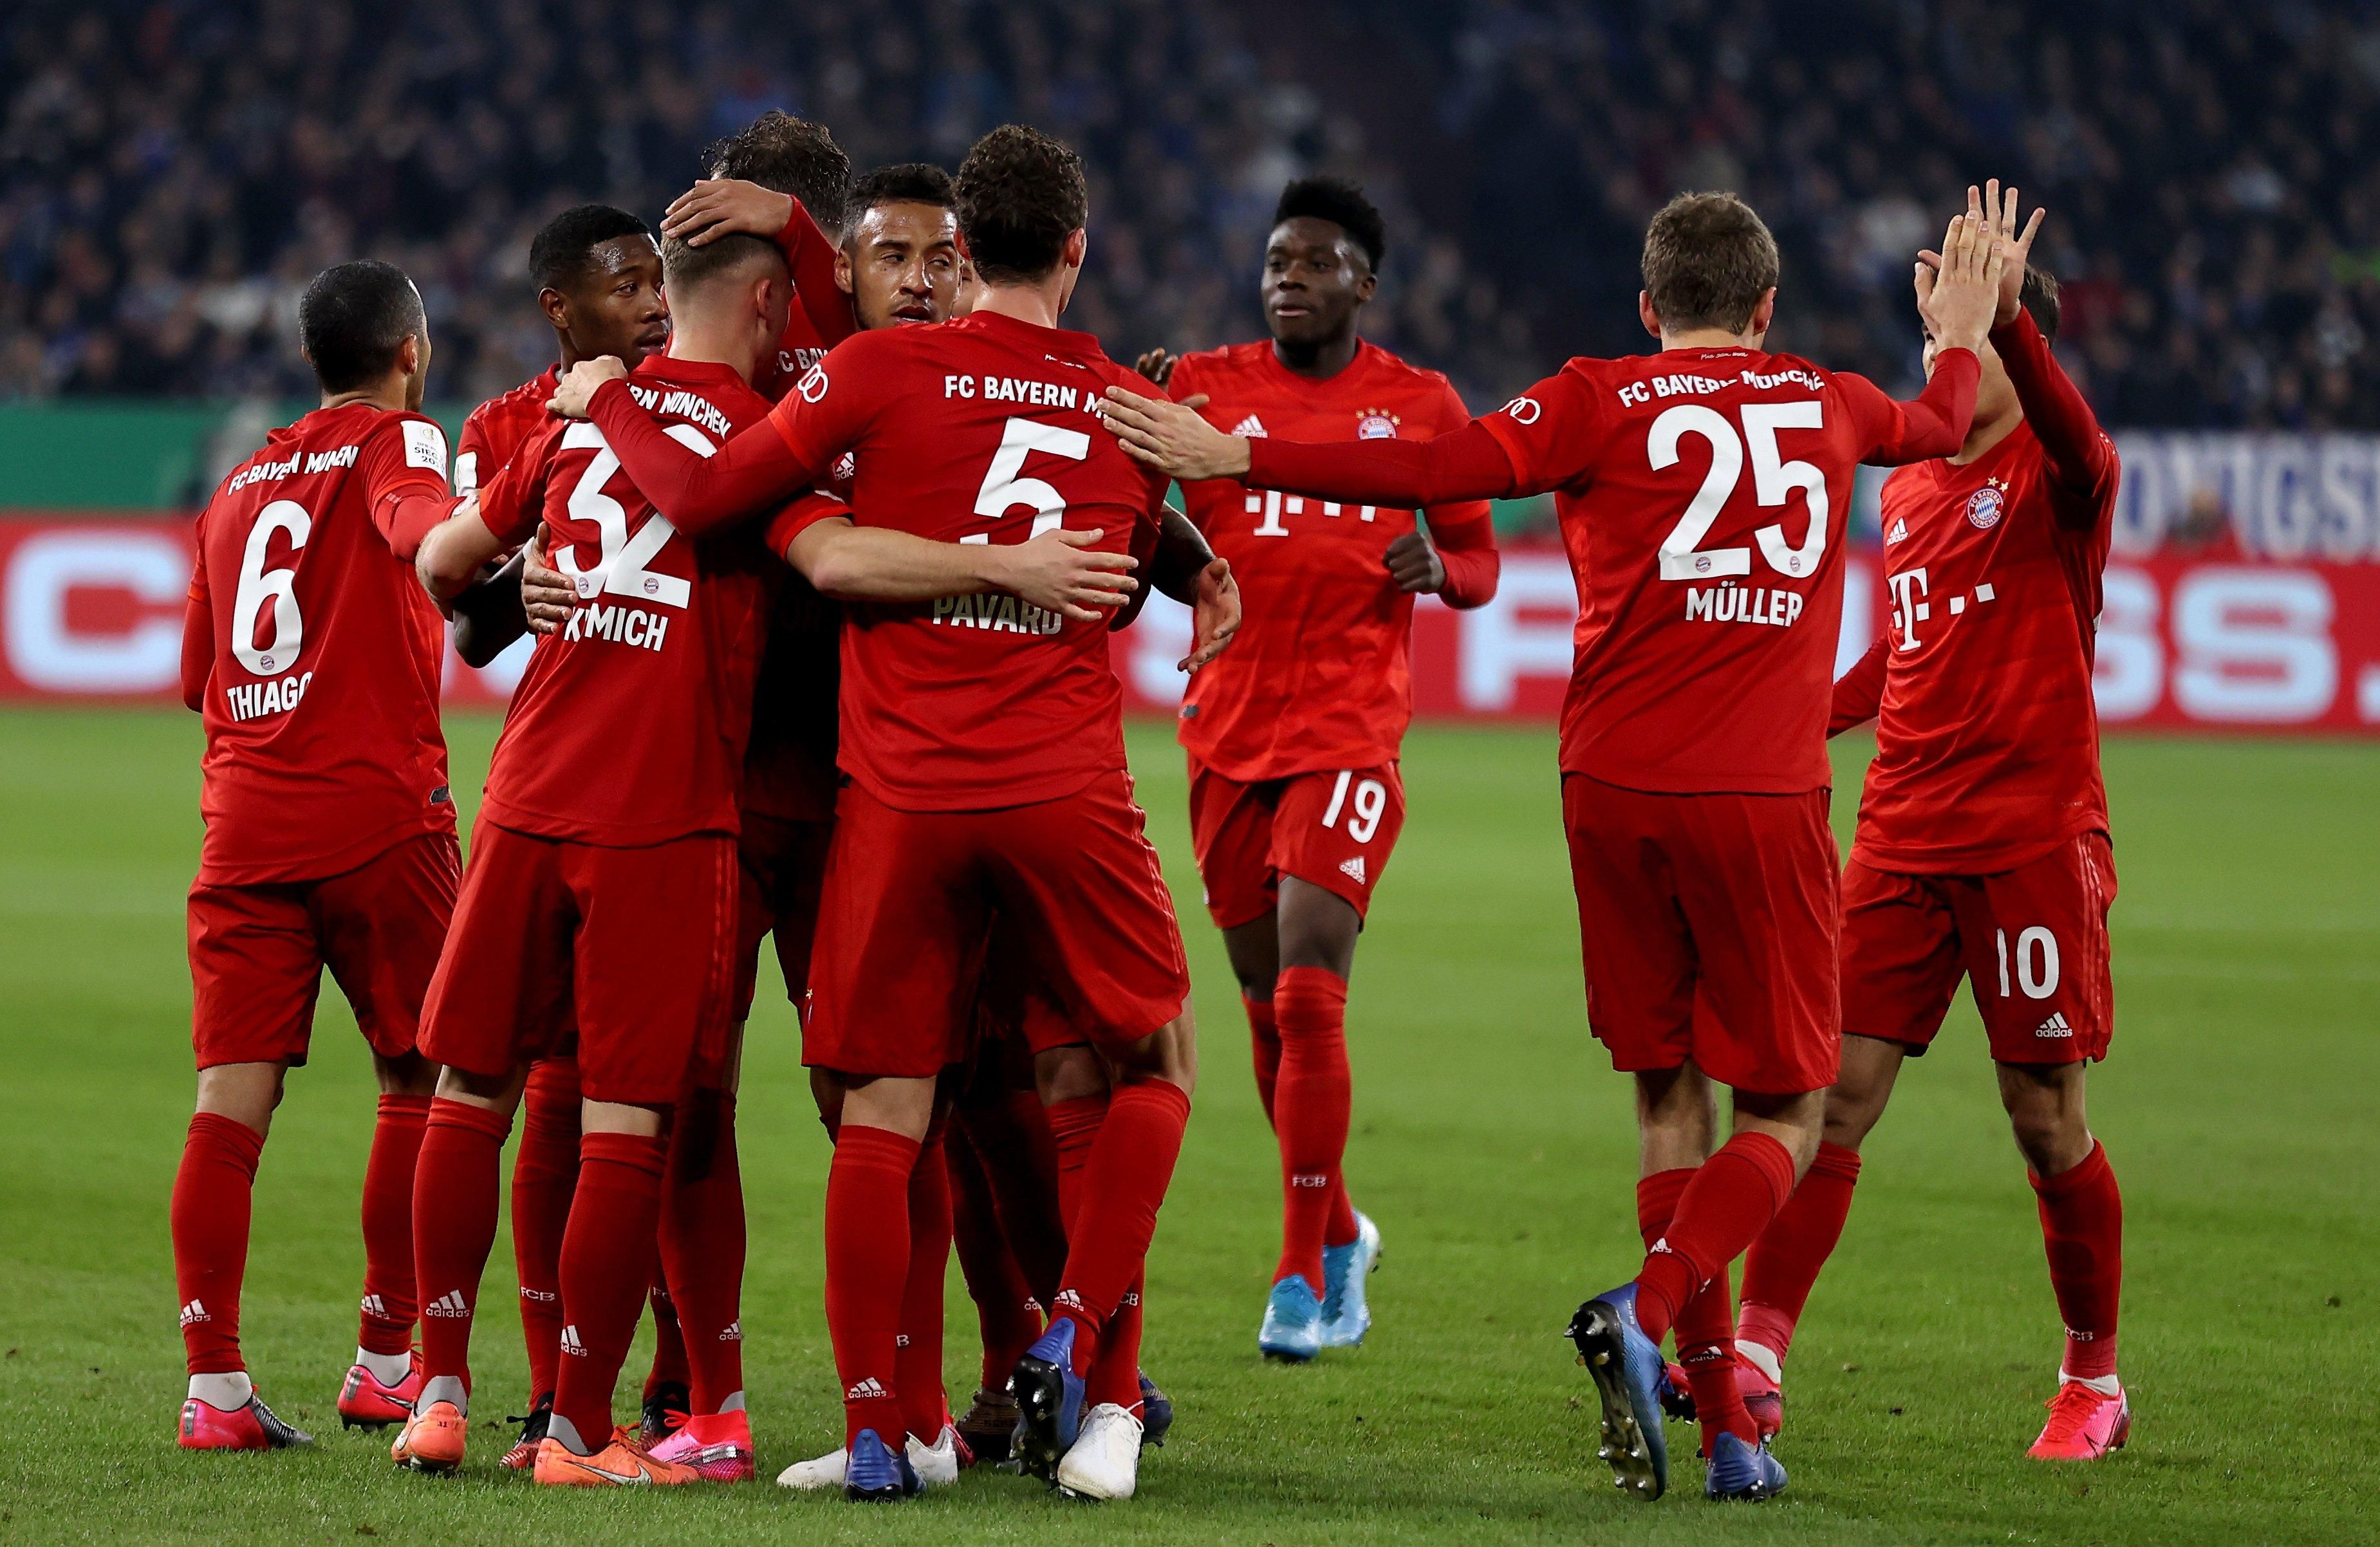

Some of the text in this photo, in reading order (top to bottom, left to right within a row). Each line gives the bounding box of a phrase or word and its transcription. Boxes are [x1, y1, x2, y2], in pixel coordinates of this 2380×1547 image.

[945, 375, 975, 398] FC
[984, 376, 1077, 409] BAYERN
[1617, 381, 1650, 408] FC
[227, 470, 249, 496] FC
[960, 416, 1091, 545] 5
[1647, 400, 1829, 581] 25
[555, 421, 718, 609] 32
[232, 499, 312, 676] 6
[1686, 580, 1803, 627] MÜLLER
[933, 593, 1062, 635] PAVARD
[1321, 769, 1386, 844] 19
[1996, 925, 2059, 999] 10
[2036, 1028, 2073, 1038] adidas
[1292, 1174, 1326, 1187] FCB
[425, 1307, 470, 1318] adidas
[521, 1286, 555, 1301] FCB
[848, 1390, 887, 1399] adidas
